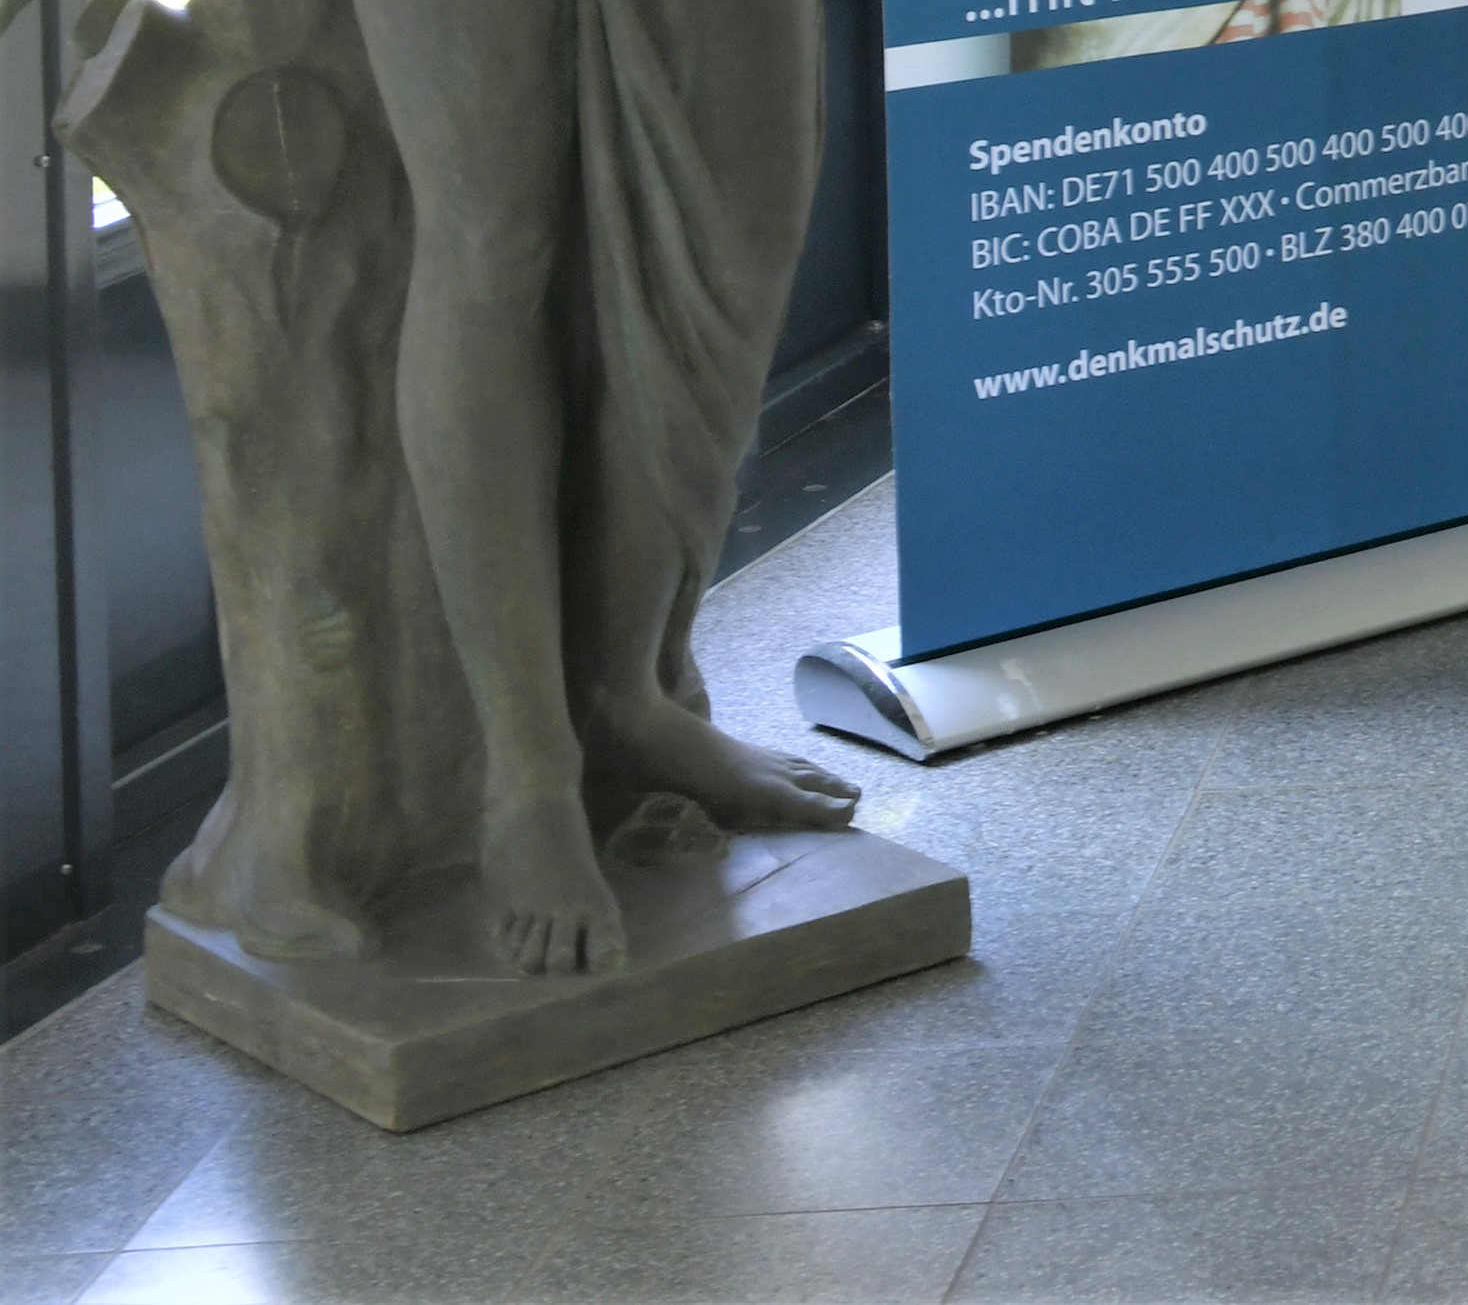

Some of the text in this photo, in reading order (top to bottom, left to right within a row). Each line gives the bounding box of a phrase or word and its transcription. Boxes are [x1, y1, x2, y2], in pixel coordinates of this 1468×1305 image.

[969, 112, 1207, 175] Spendenkonto
[970, 182, 1055, 222] IBAN:
[1062, 168, 1134, 207] DE71
[1145, 158, 1200, 192] 500
[1207, 148, 1259, 181] 400
[1265, 138, 1316, 172] 500
[1322, 128, 1374, 160] 400
[1380, 119, 1430, 152] 500
[972, 233, 1030, 270] BIC:
[1037, 216, 1122, 257] COBA
[1130, 207, 1172, 242] DE
[1179, 201, 1213, 233] FF
[1220, 189, 1275, 226] XXX
[973, 276, 1079, 320] Kto-Nr.
[1086, 263, 1138, 299] 305
[1146, 252, 1200, 288] 555
[1209, 242, 1259, 277] 500
[1281, 227, 1333, 262] BLZ
[1340, 217, 1391, 251] 380
[1396, 207, 1445, 239] 400
[974, 301, 1348, 399] www.denkmalschutz.de
